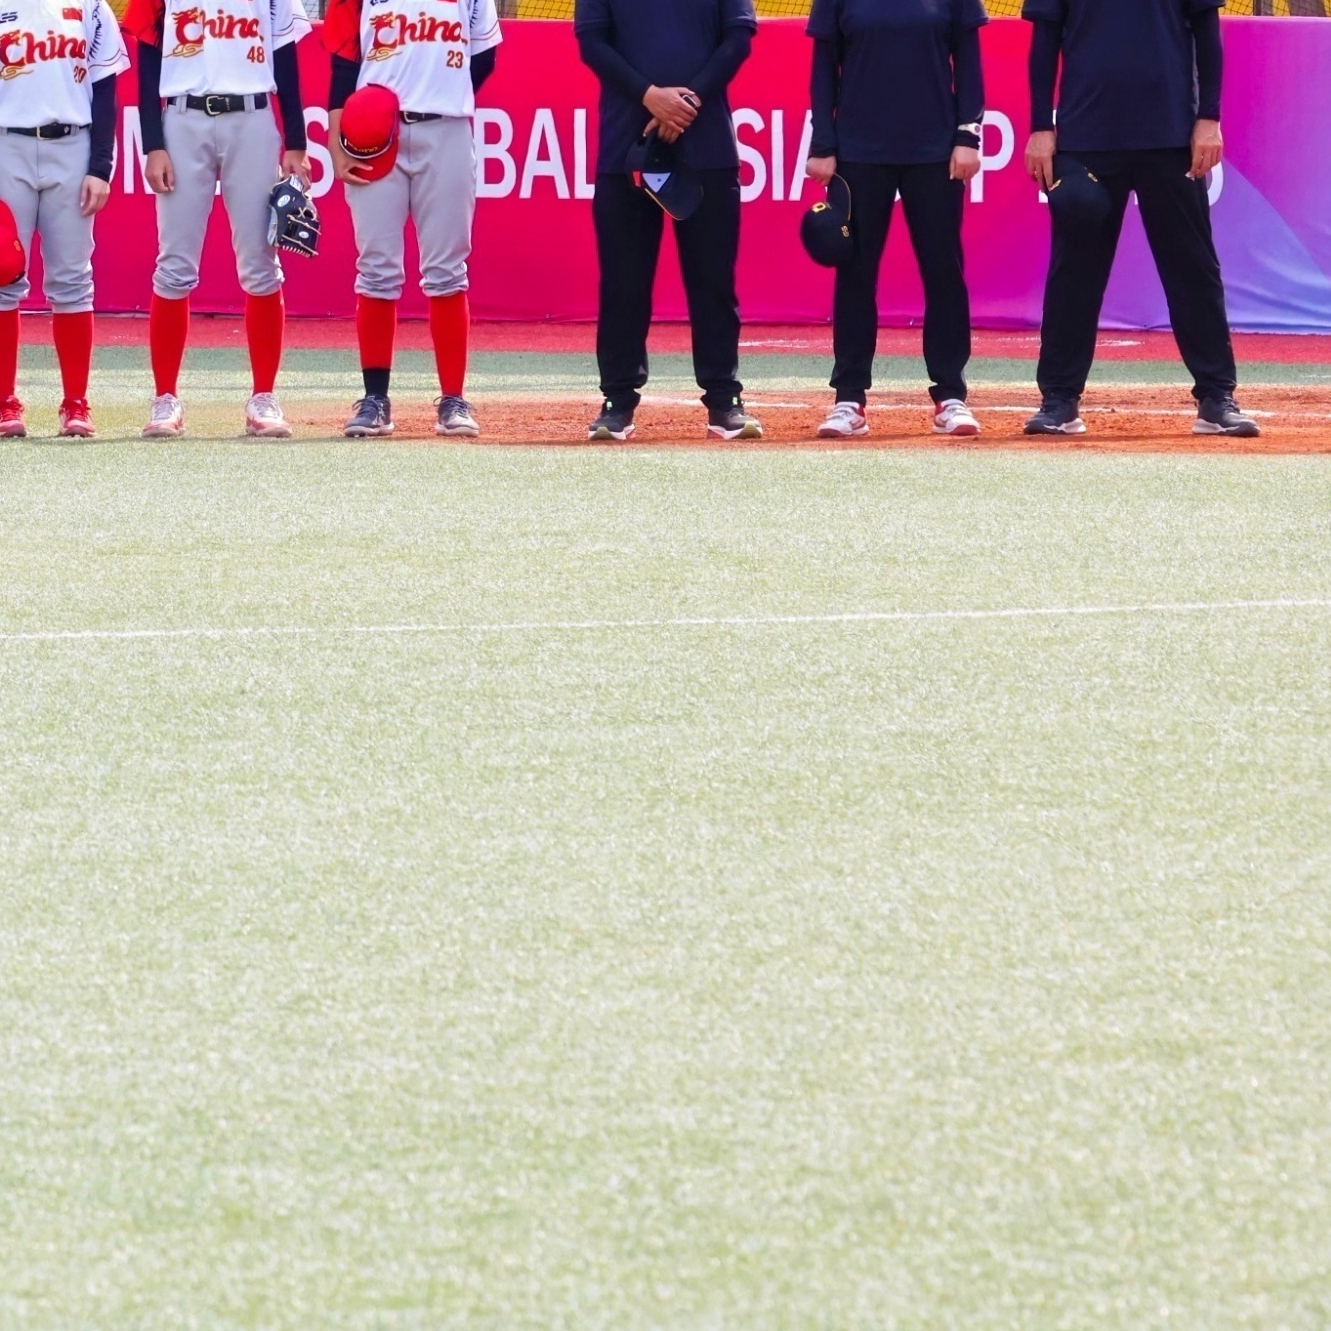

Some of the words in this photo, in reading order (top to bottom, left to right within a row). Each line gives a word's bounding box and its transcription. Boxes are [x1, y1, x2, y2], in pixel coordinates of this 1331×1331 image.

[171, 7, 264, 46] China
[369, 11, 468, 49] China
[247, 46, 265, 64] 48
[446, 50, 464, 69] 23
